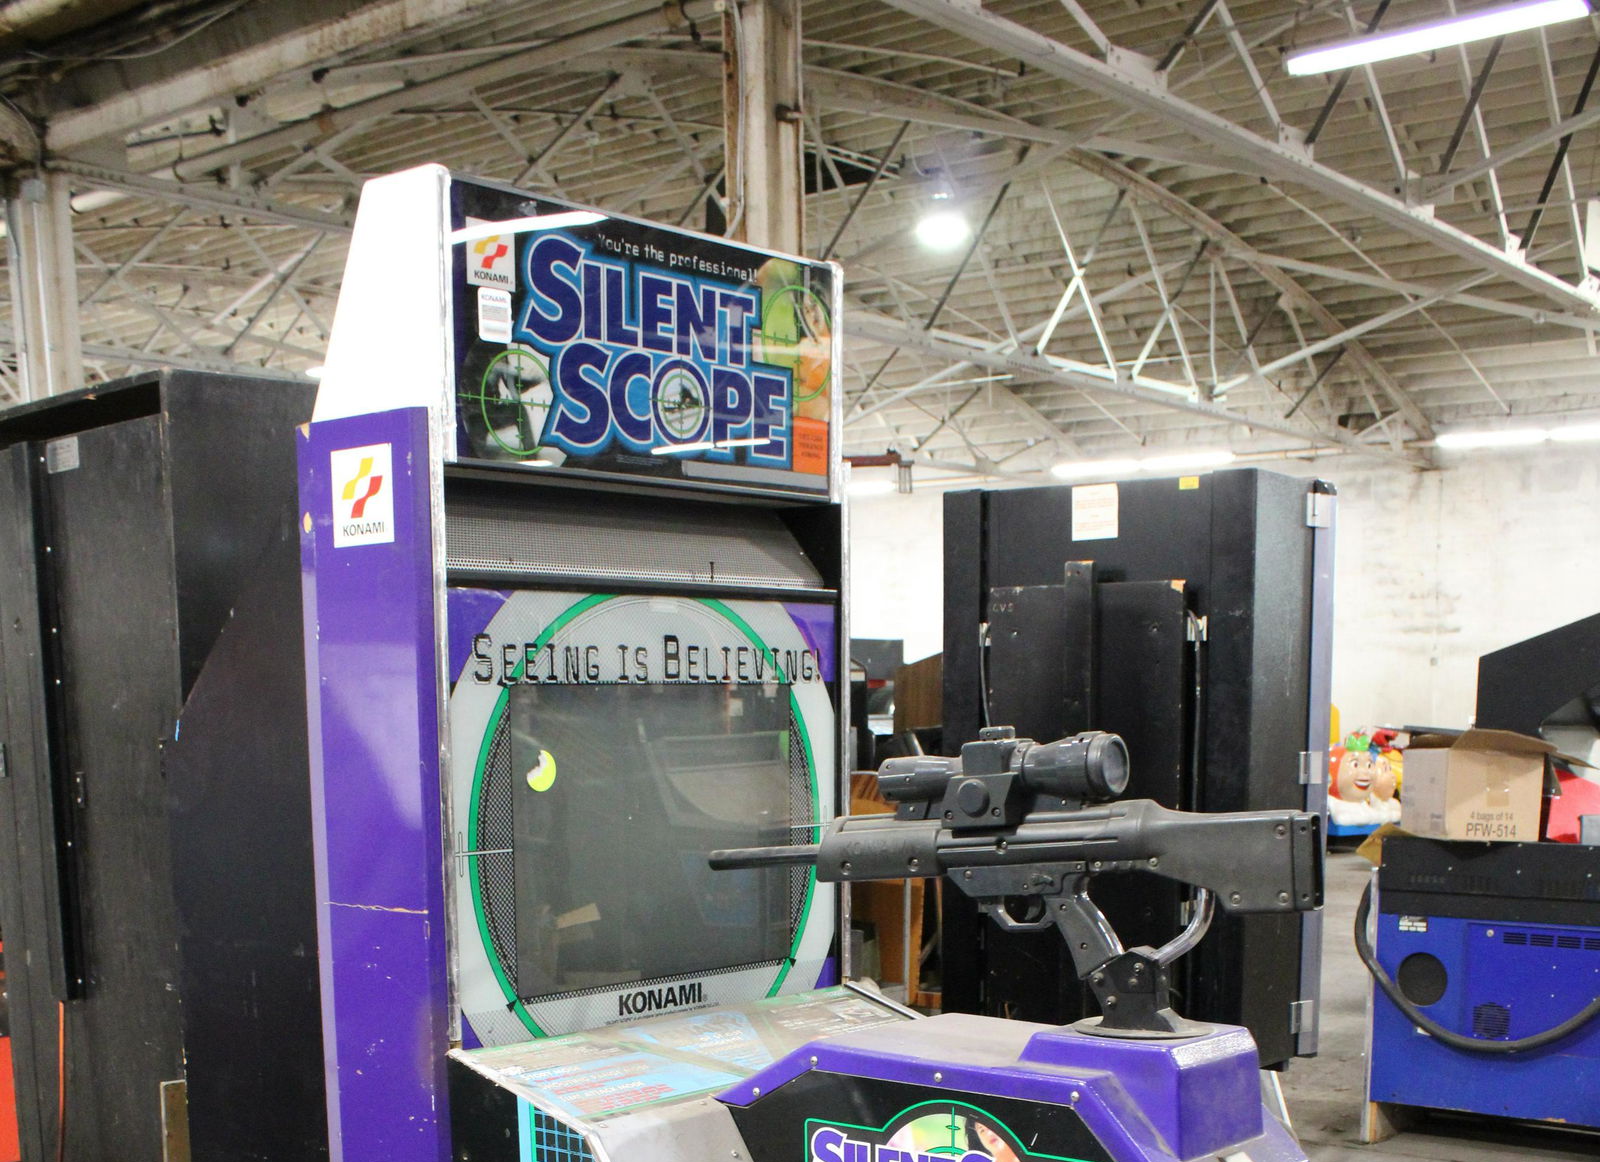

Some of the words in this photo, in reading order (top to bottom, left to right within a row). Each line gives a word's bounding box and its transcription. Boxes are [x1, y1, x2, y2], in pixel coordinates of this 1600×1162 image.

[598, 233, 639, 256] You're
[644, 244, 665, 262] the
[669, 252, 758, 283] professional!
[474, 270, 509, 284] KONAMI
[521, 233, 757, 366] SILENT
[550, 341, 789, 461] SCOPE
[343, 521, 385, 537] KONAMI
[471, 633, 600, 685] SEEING
[617, 644, 649, 685] IS
[1466, 823, 1516, 838] PFW-514
[1476, 812, 1495, 822] bags
[1496, 812, 1503, 820] of
[1505, 812, 1513, 820] 14
[618, 982, 702, 1016] KONAMI
